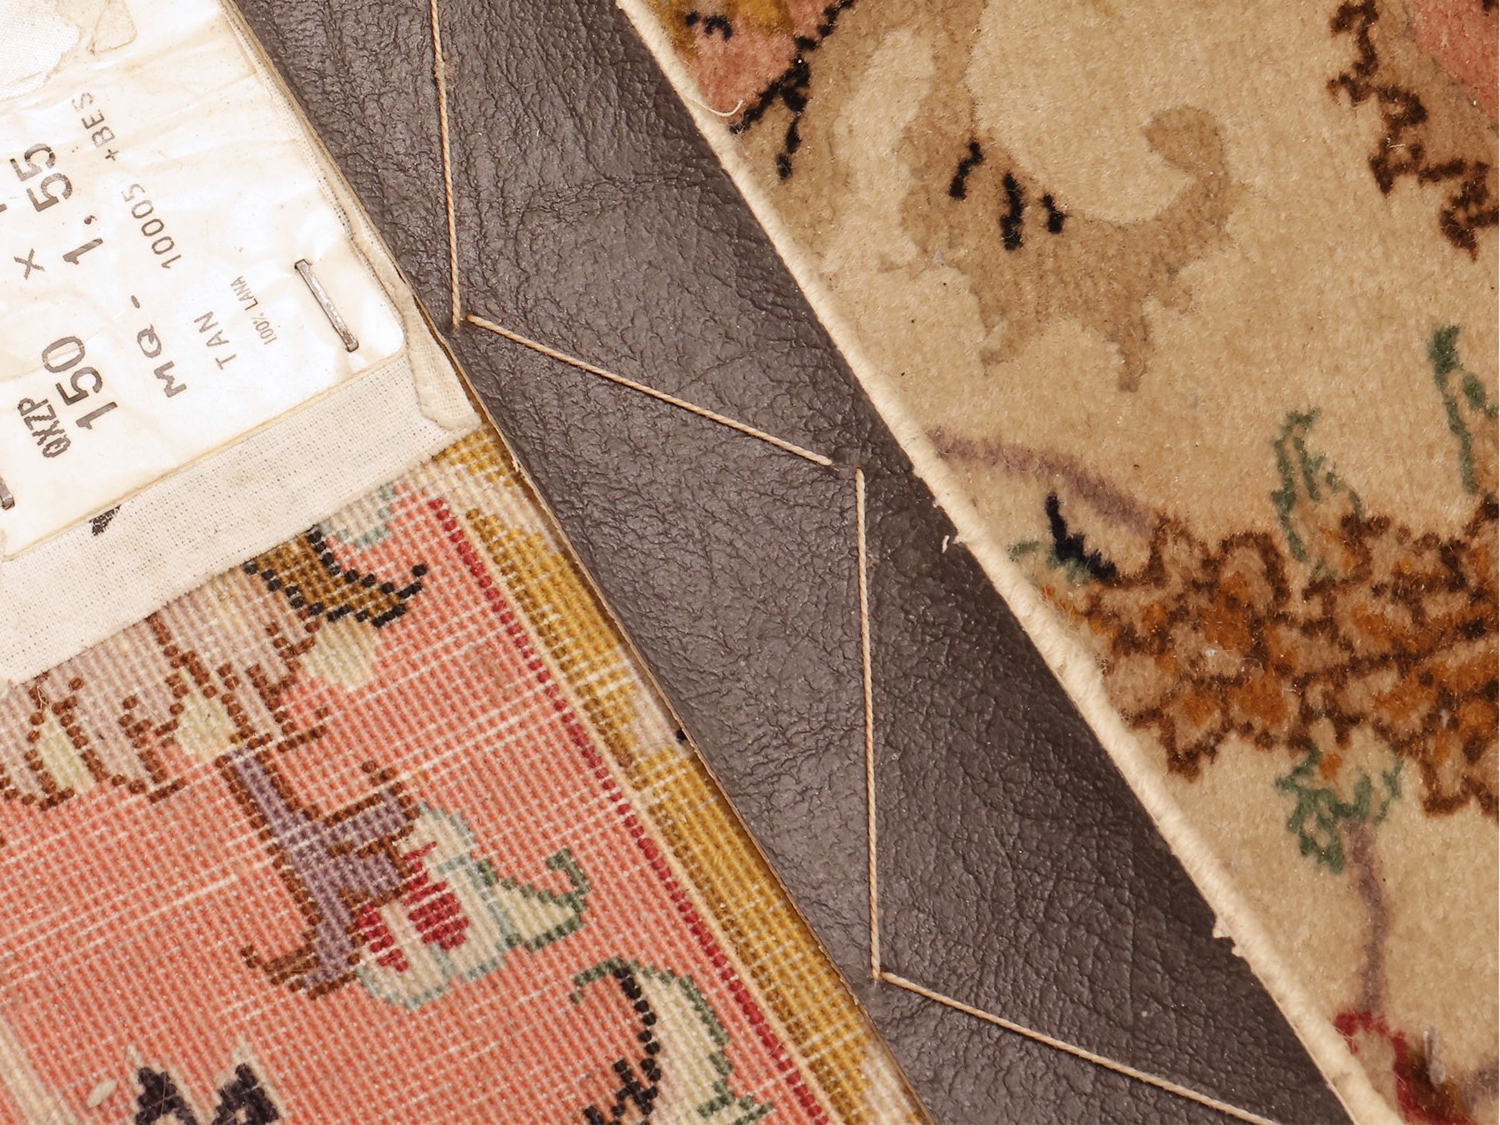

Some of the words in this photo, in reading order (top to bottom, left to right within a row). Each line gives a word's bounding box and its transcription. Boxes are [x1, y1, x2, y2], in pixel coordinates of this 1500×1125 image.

[121, 183, 182, 269] 10005
[230, 276, 258, 311] LANA
[194, 311, 237, 370] TAN
[252, 312, 277, 346] 100%
[41, 336, 118, 430] 150
[17, 397, 71, 458] QXZP
